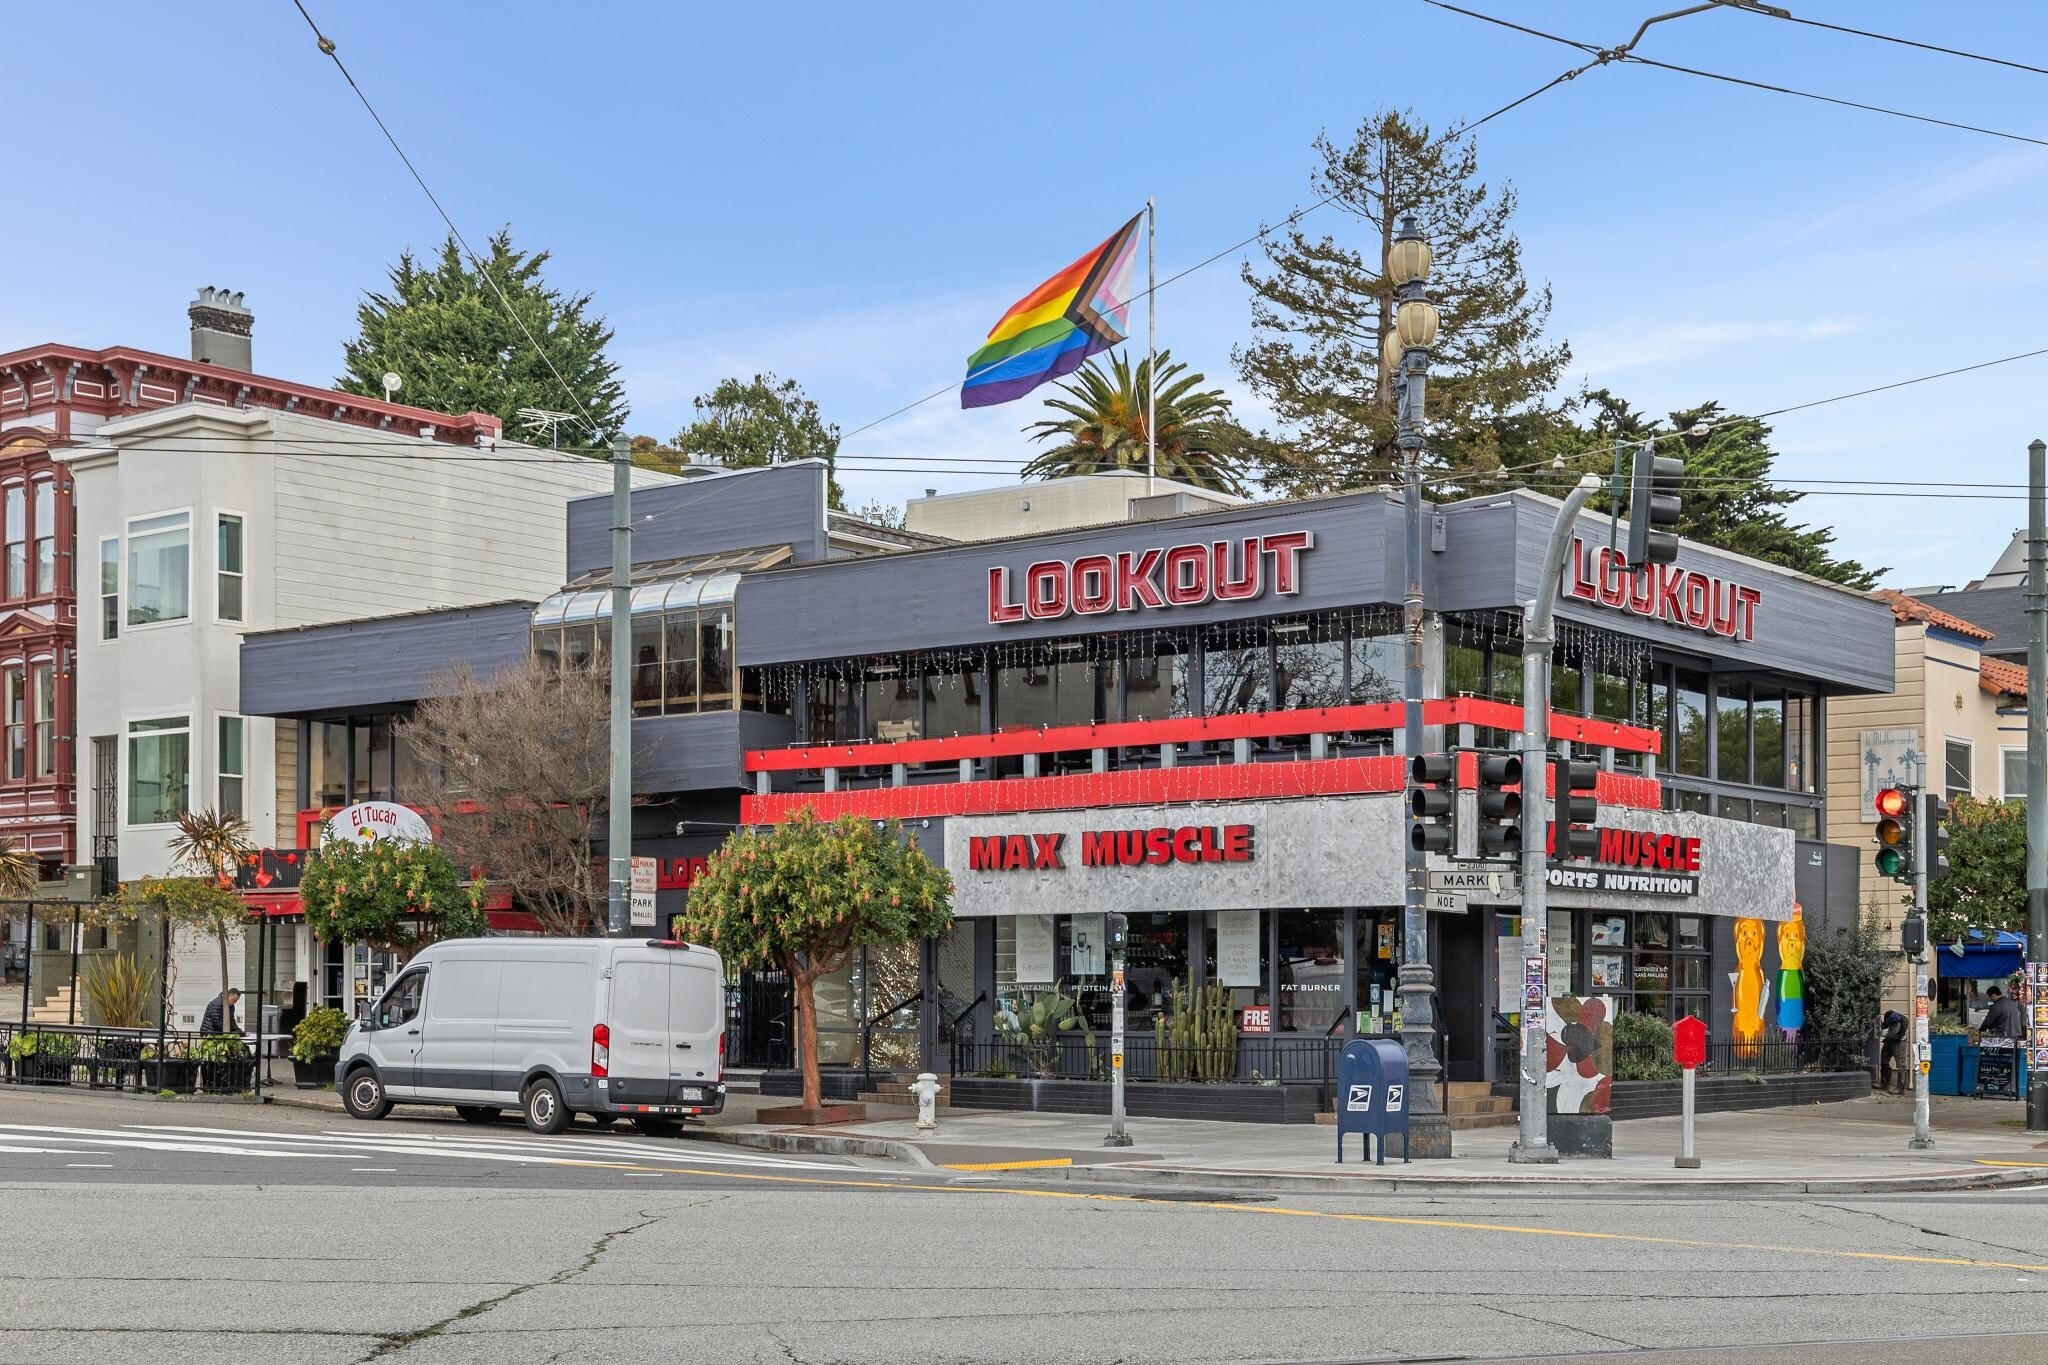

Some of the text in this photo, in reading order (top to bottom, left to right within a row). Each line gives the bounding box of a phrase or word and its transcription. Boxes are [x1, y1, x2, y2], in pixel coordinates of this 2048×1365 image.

[988, 530, 1314, 625] LOOKOUT
[1564, 536, 1762, 642] LOOKOUT
[351, 806, 397, 827] El Tucán
[969, 824, 1254, 871] MAX MUSCLE
[1600, 827, 1700, 871] MUSCLE
[1546, 869, 1693, 894] ORTS NUTRITION
[632, 899, 653, 908] PARK
[1437, 896, 1454, 908] NOE
[632, 911, 653, 919] PARALLEL
[1243, 1010, 1270, 1026] FRE
